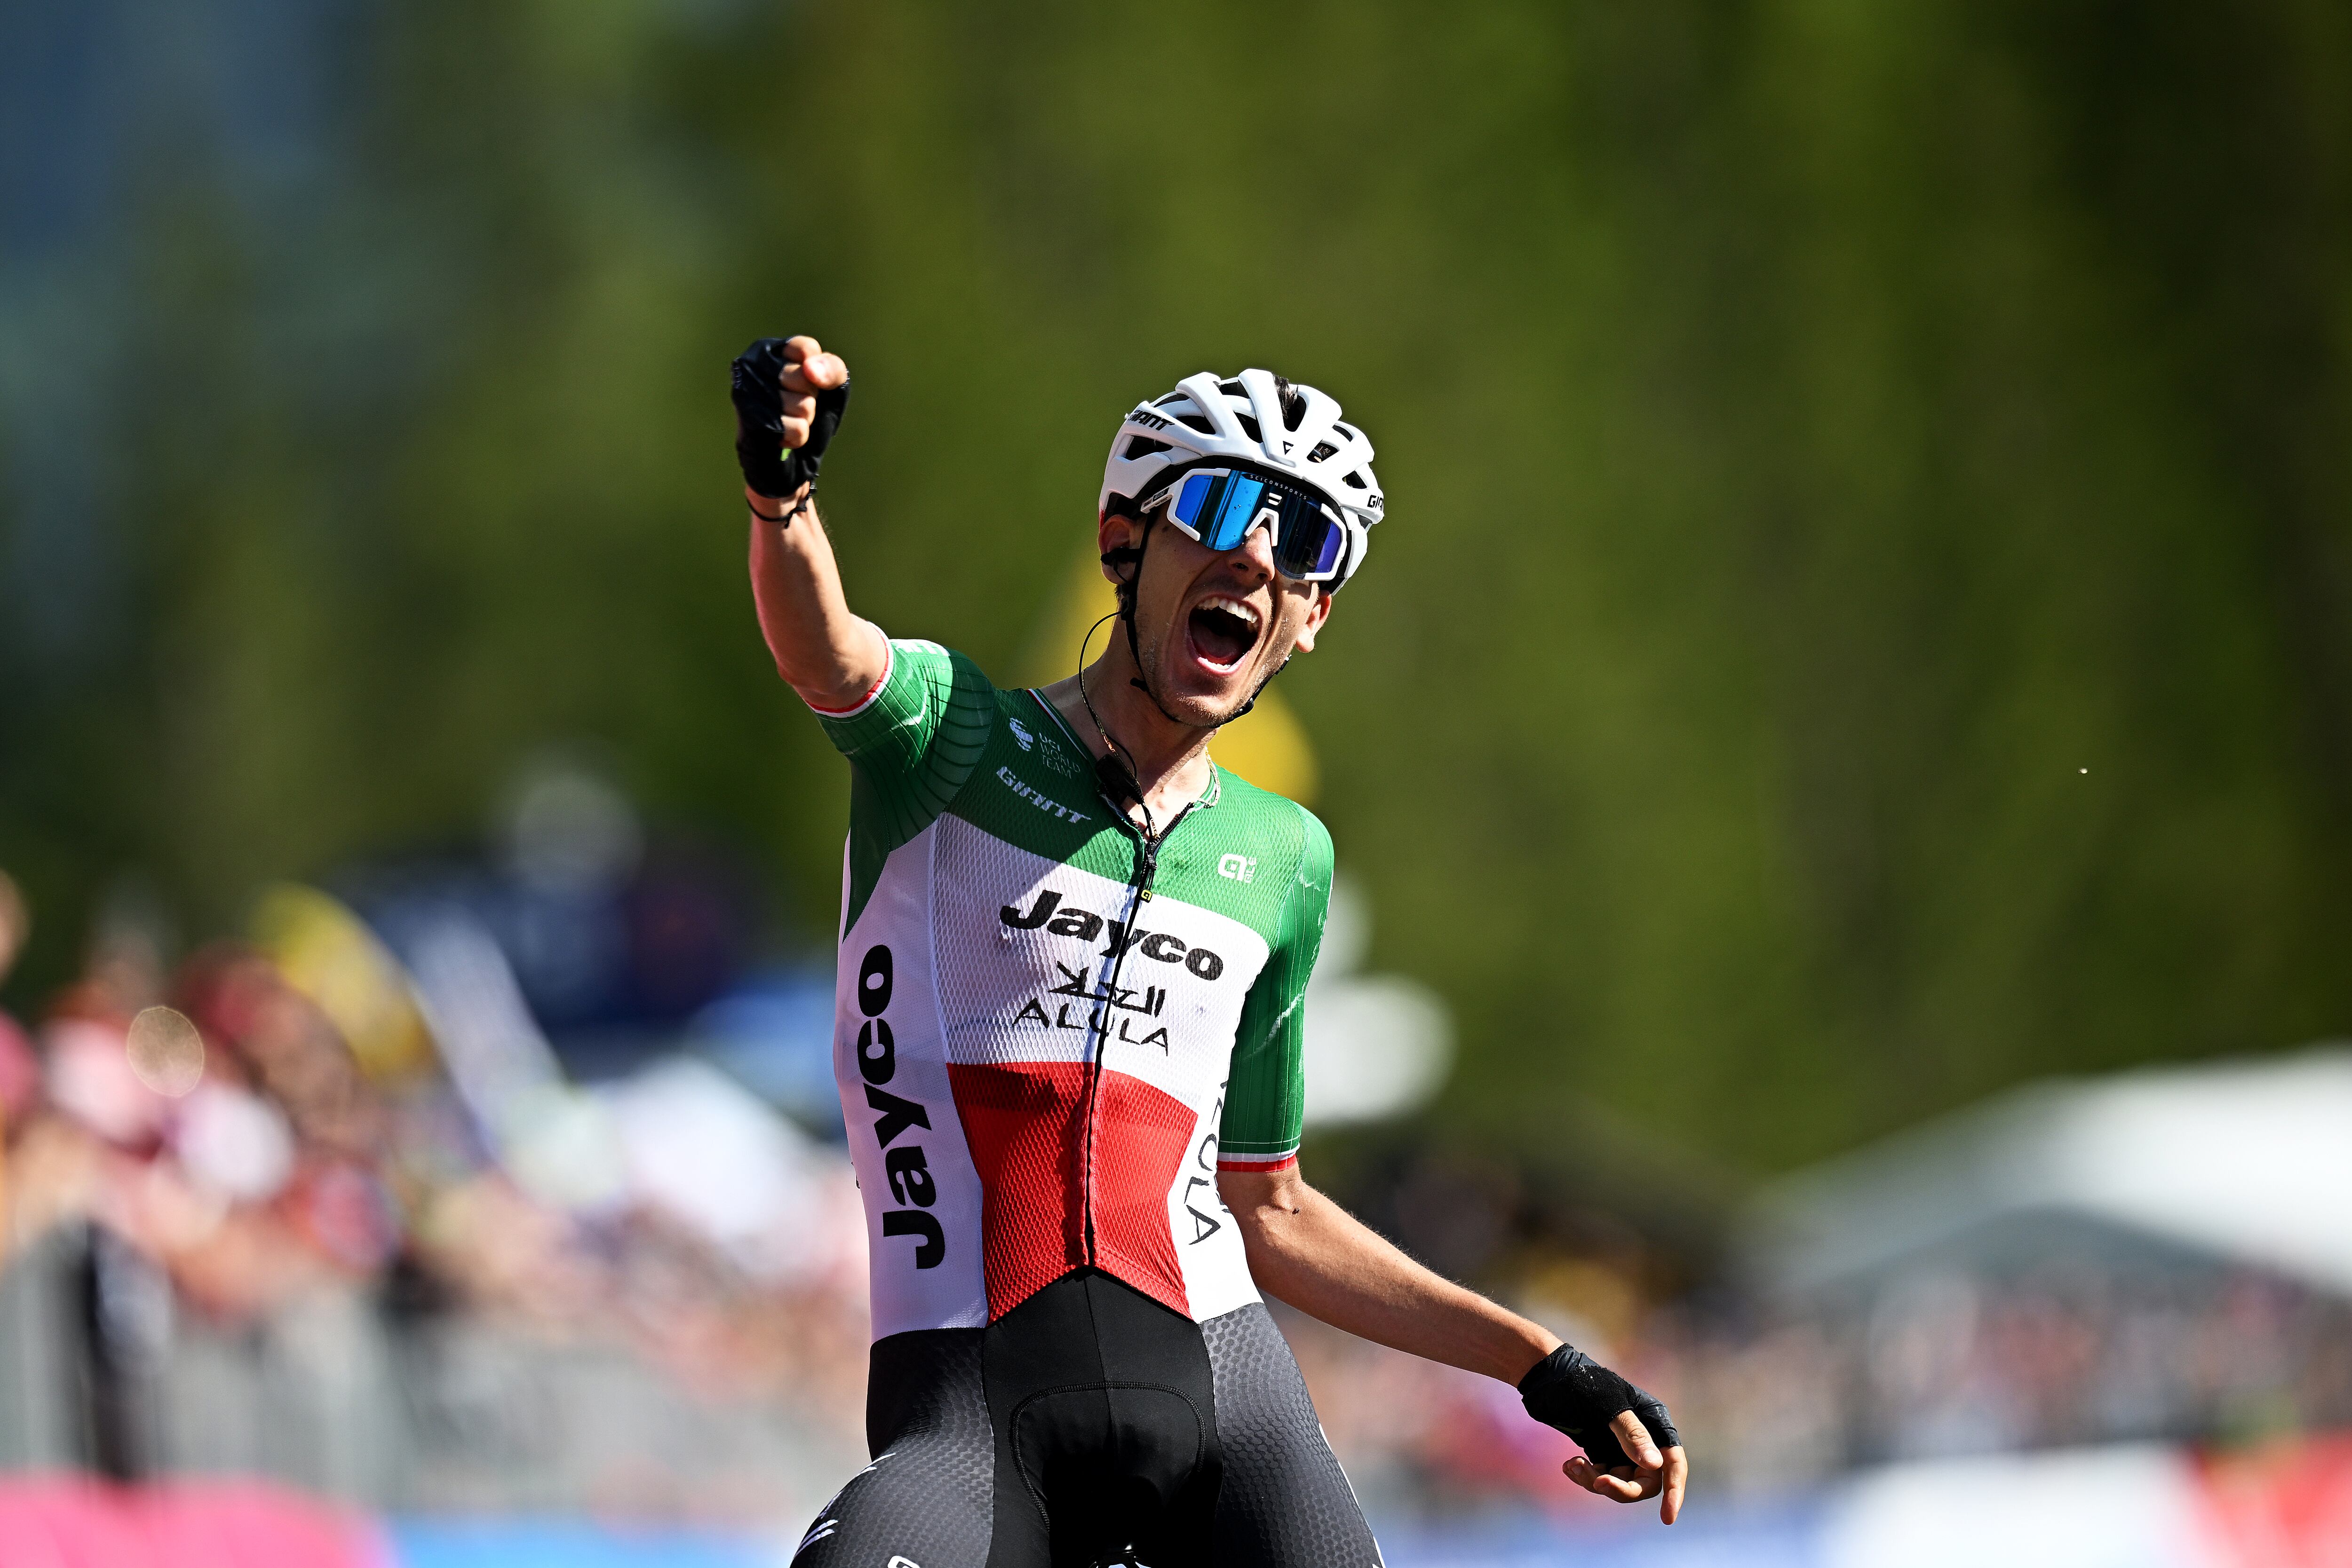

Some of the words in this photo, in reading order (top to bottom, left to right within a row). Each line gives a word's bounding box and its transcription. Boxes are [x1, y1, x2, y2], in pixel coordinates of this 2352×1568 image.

[1250, 474, 1307, 500] SCICONSPORTS
[1367, 494, 1383, 511] GIA
[1039, 732, 1060, 752] UCI
[1040, 742, 1081, 773] WORLD
[1041, 753, 1072, 779] TEAM
[996, 766, 1091, 824] GIANT
[999, 889, 1224, 981] Jayco
[1009, 996, 1168, 1057] ALULA
[856, 944, 946, 1270] Jayco
